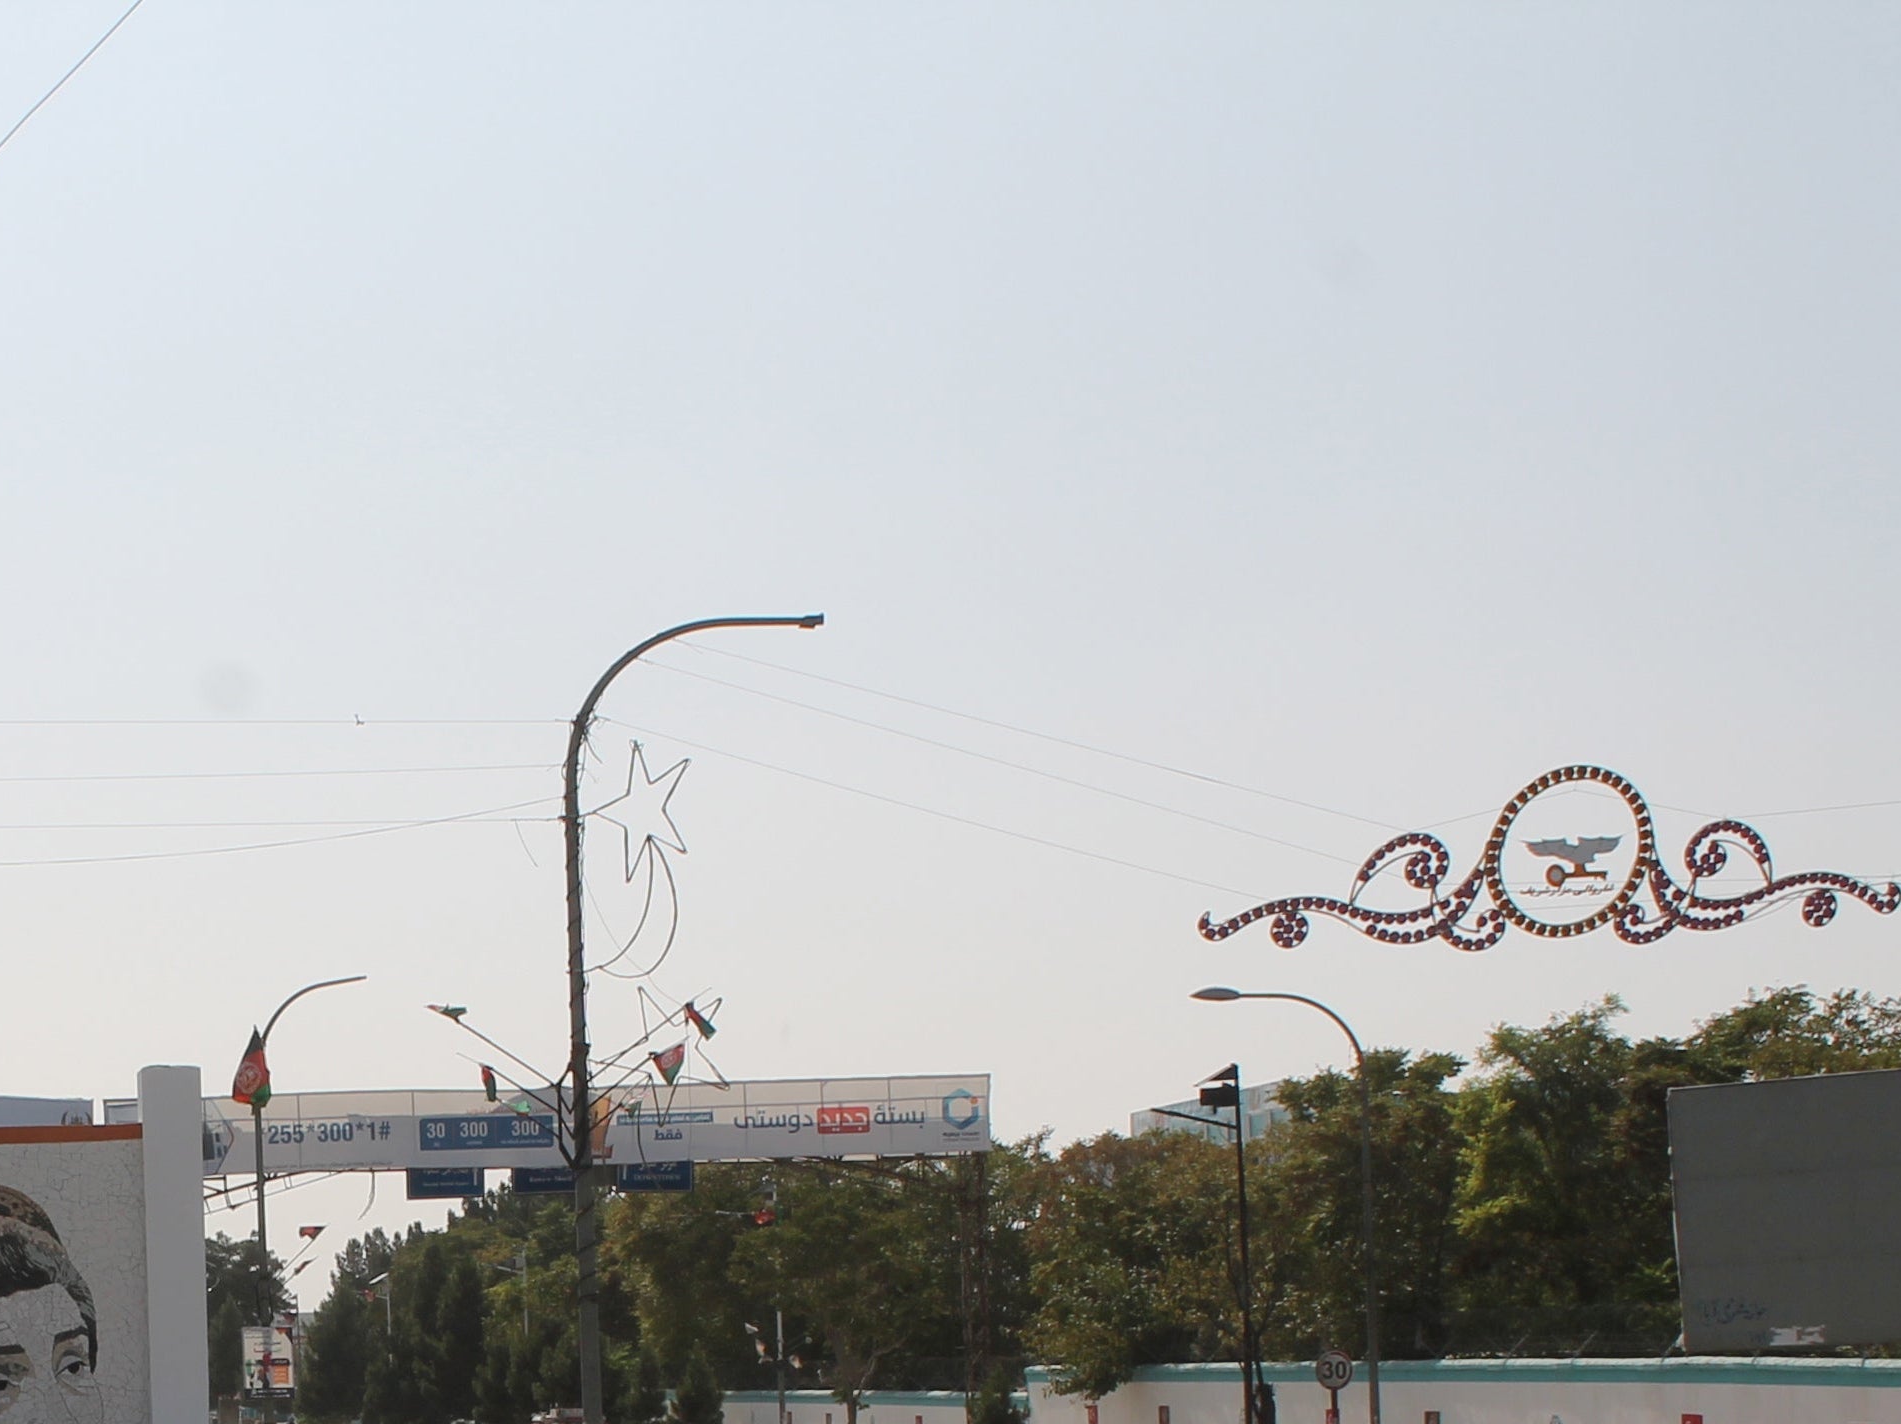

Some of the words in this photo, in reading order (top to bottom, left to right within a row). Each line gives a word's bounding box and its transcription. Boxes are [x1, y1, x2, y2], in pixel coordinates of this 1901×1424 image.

[426, 1122, 446, 1139] 30
[459, 1121, 489, 1138] 300
[511, 1120, 540, 1137] 300
[734, 1110, 813, 1134] دوستی
[819, 1112, 868, 1132] جدید
[654, 1129, 683, 1141] فقط
[1321, 1360, 1347, 1380] 30
